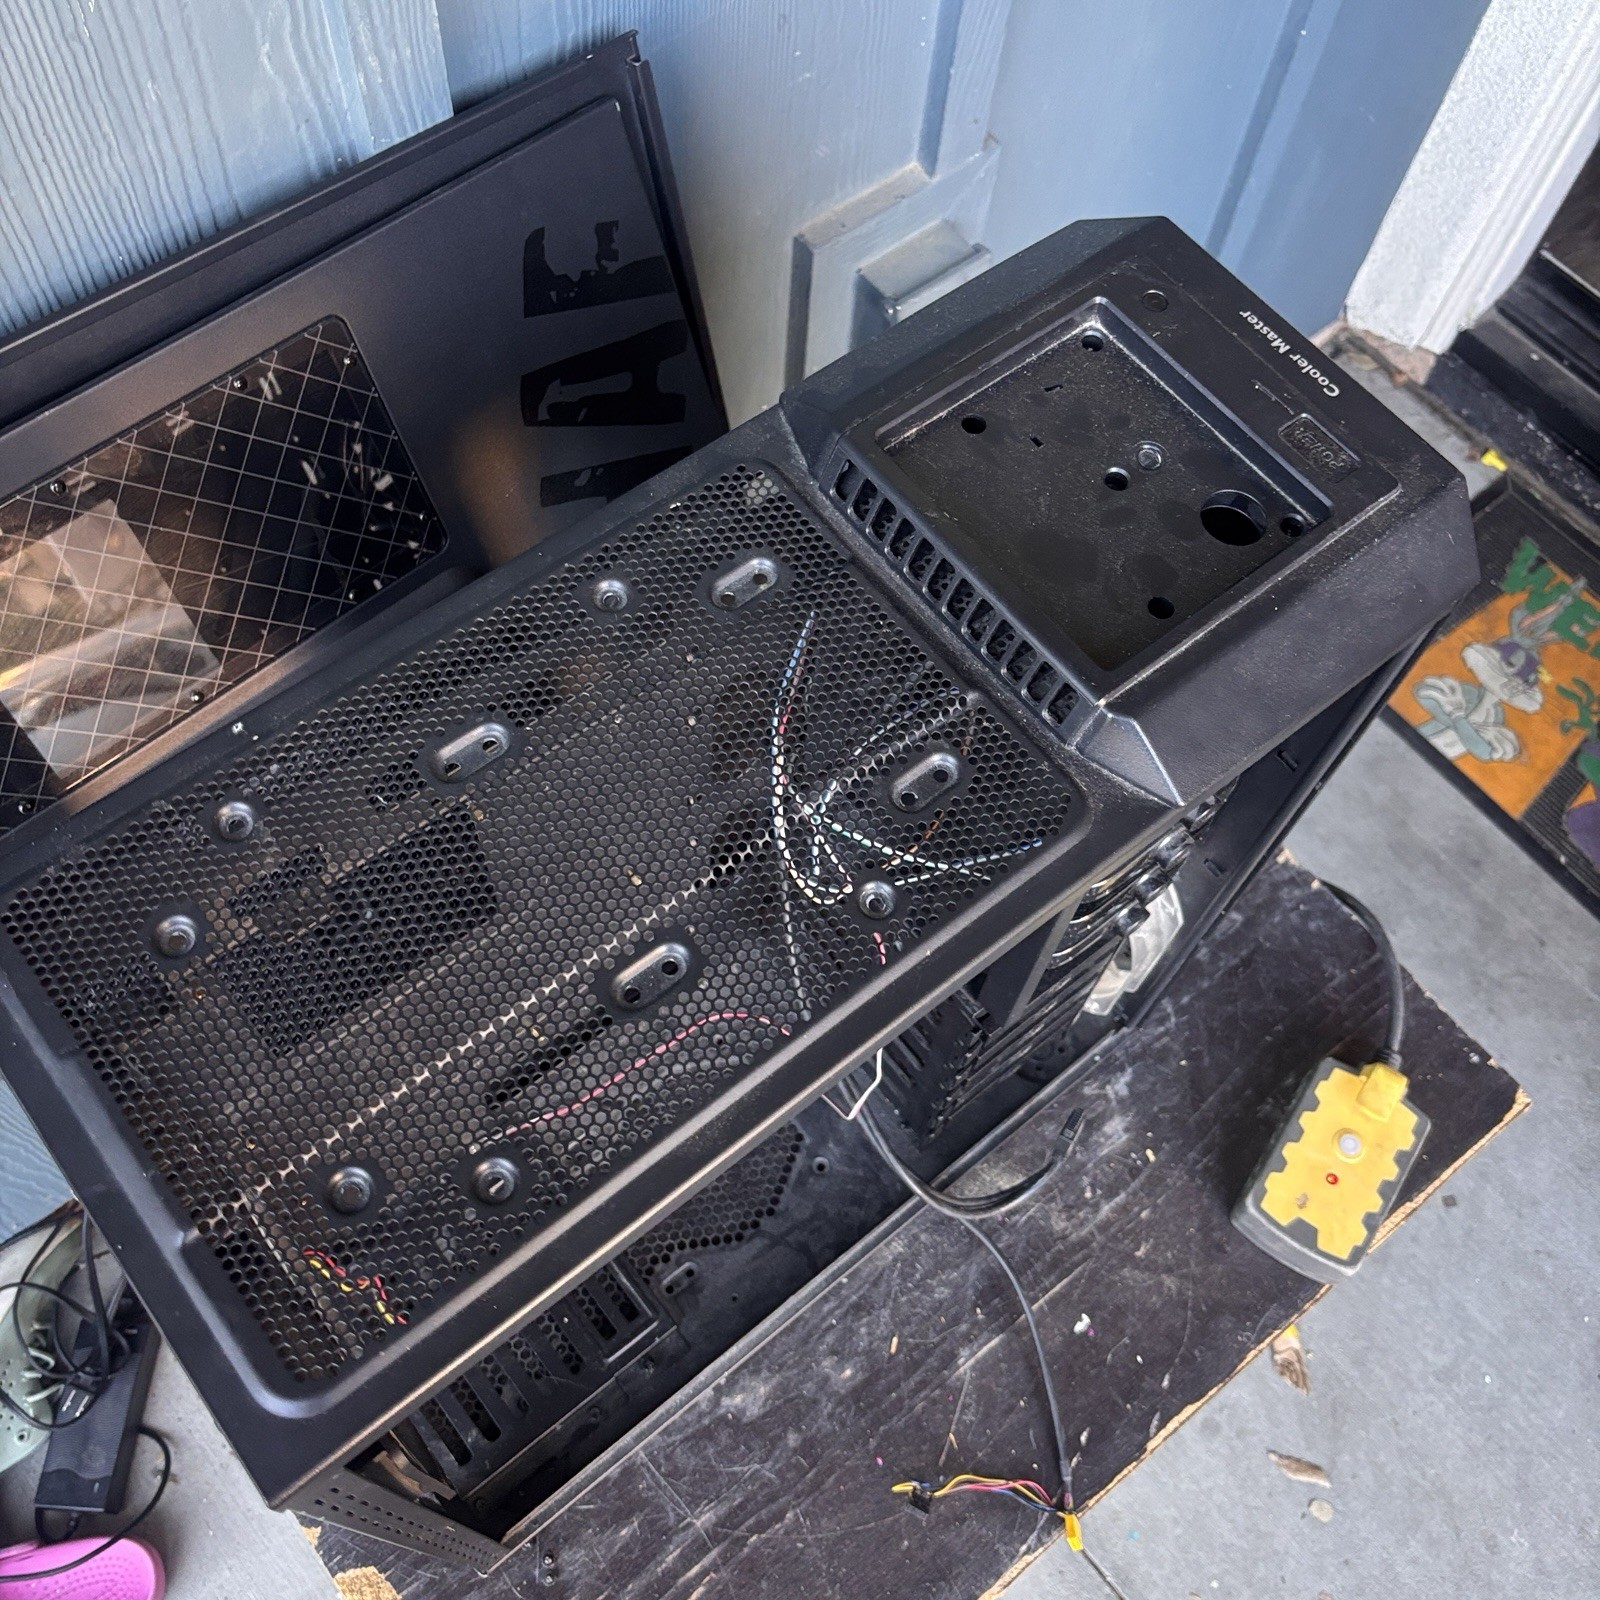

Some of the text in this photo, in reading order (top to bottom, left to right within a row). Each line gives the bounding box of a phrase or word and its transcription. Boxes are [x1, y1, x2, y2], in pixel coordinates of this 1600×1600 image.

[1239, 310, 1340, 398] Cooler Master
[1501, 537, 1600, 660] WE
